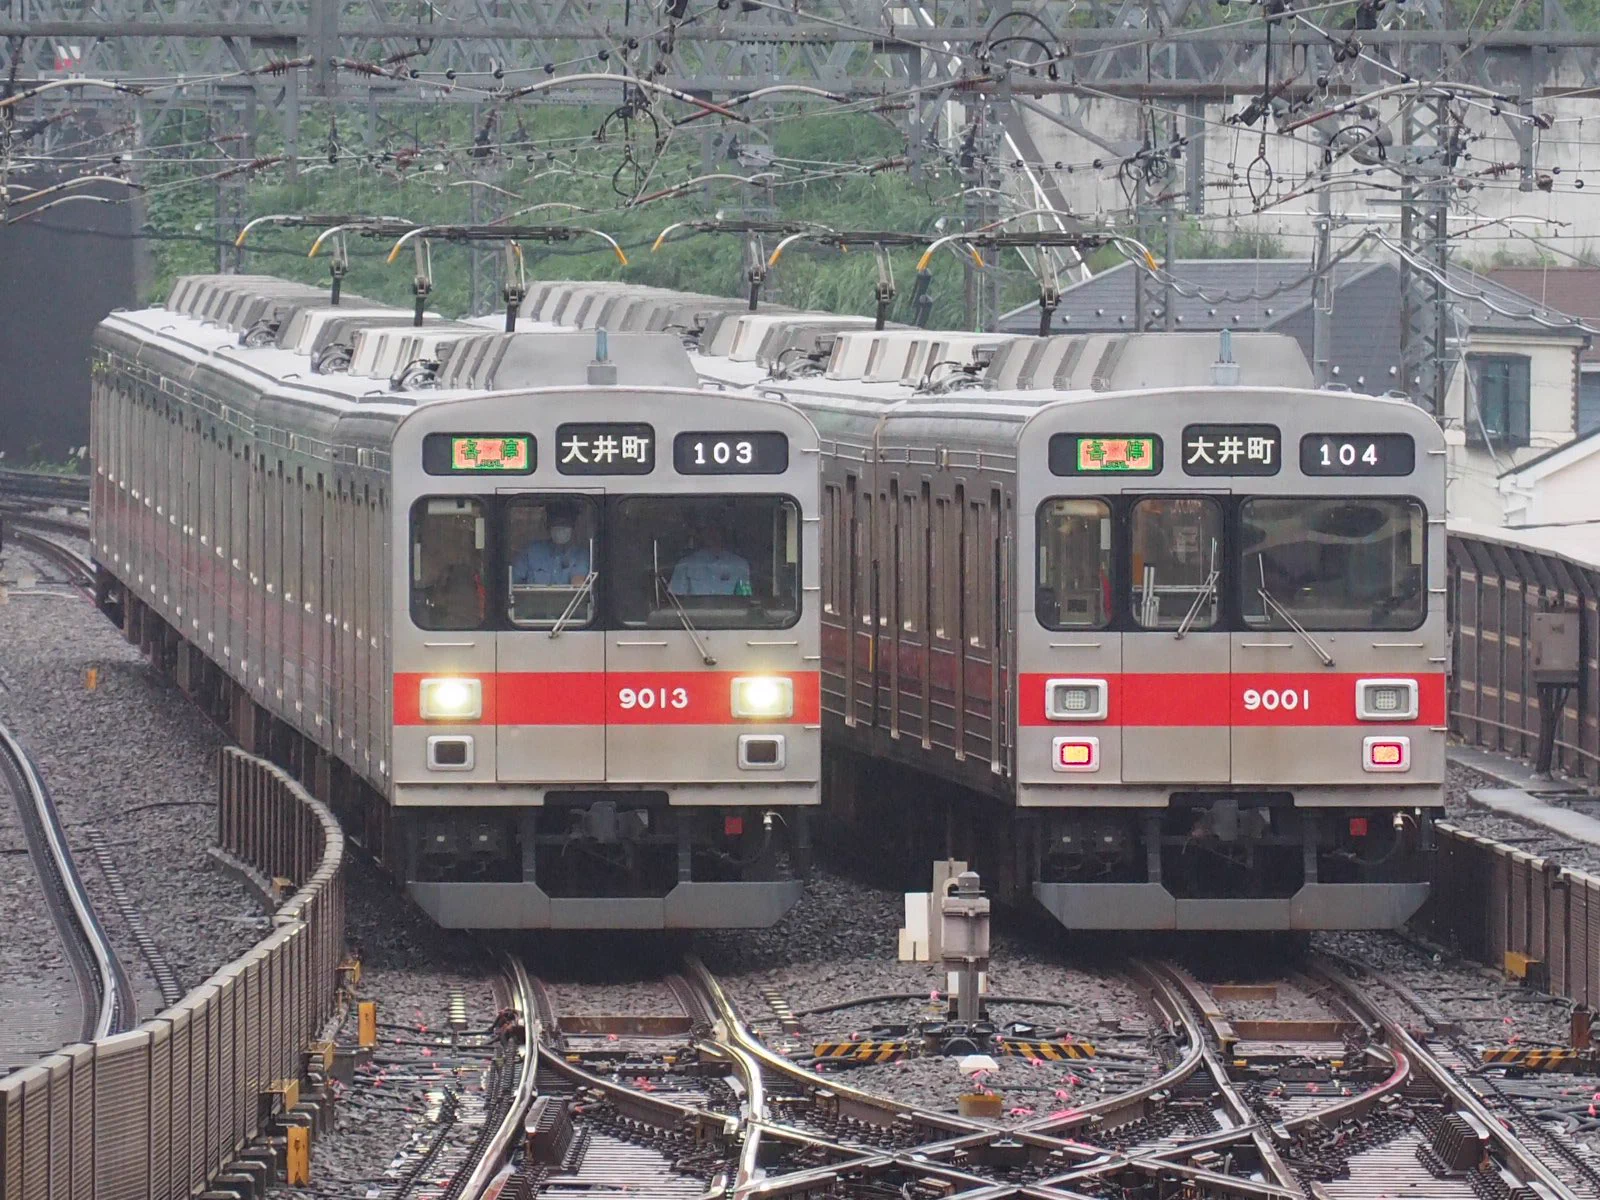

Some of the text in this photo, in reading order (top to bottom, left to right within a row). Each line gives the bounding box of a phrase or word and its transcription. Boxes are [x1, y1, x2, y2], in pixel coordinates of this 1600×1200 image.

[561, 435, 648, 464] 大井町
[693, 441, 753, 465] 103
[1187, 436, 1275, 464] 大井町
[1319, 443, 1378, 466] 104
[619, 687, 689, 709] 9013
[1243, 689, 1309, 711] 9001
